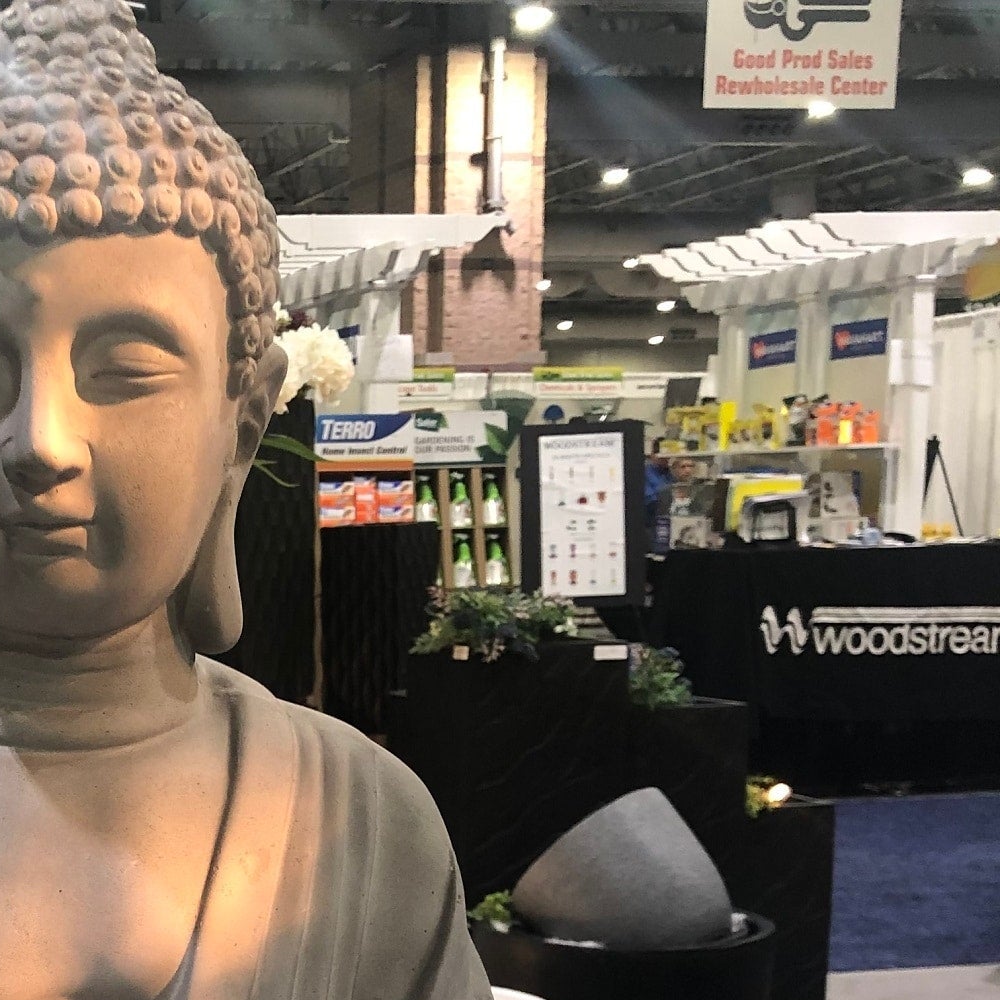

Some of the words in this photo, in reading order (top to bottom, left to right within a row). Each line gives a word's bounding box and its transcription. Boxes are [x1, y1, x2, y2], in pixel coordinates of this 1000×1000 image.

[733, 48, 776, 69] Good
[782, 49, 823, 69] Prod
[828, 49, 874, 69] Sales
[831, 75, 888, 95] Center
[321, 419, 377, 440] TERRO
[811, 622, 1000, 655] woodstrea
